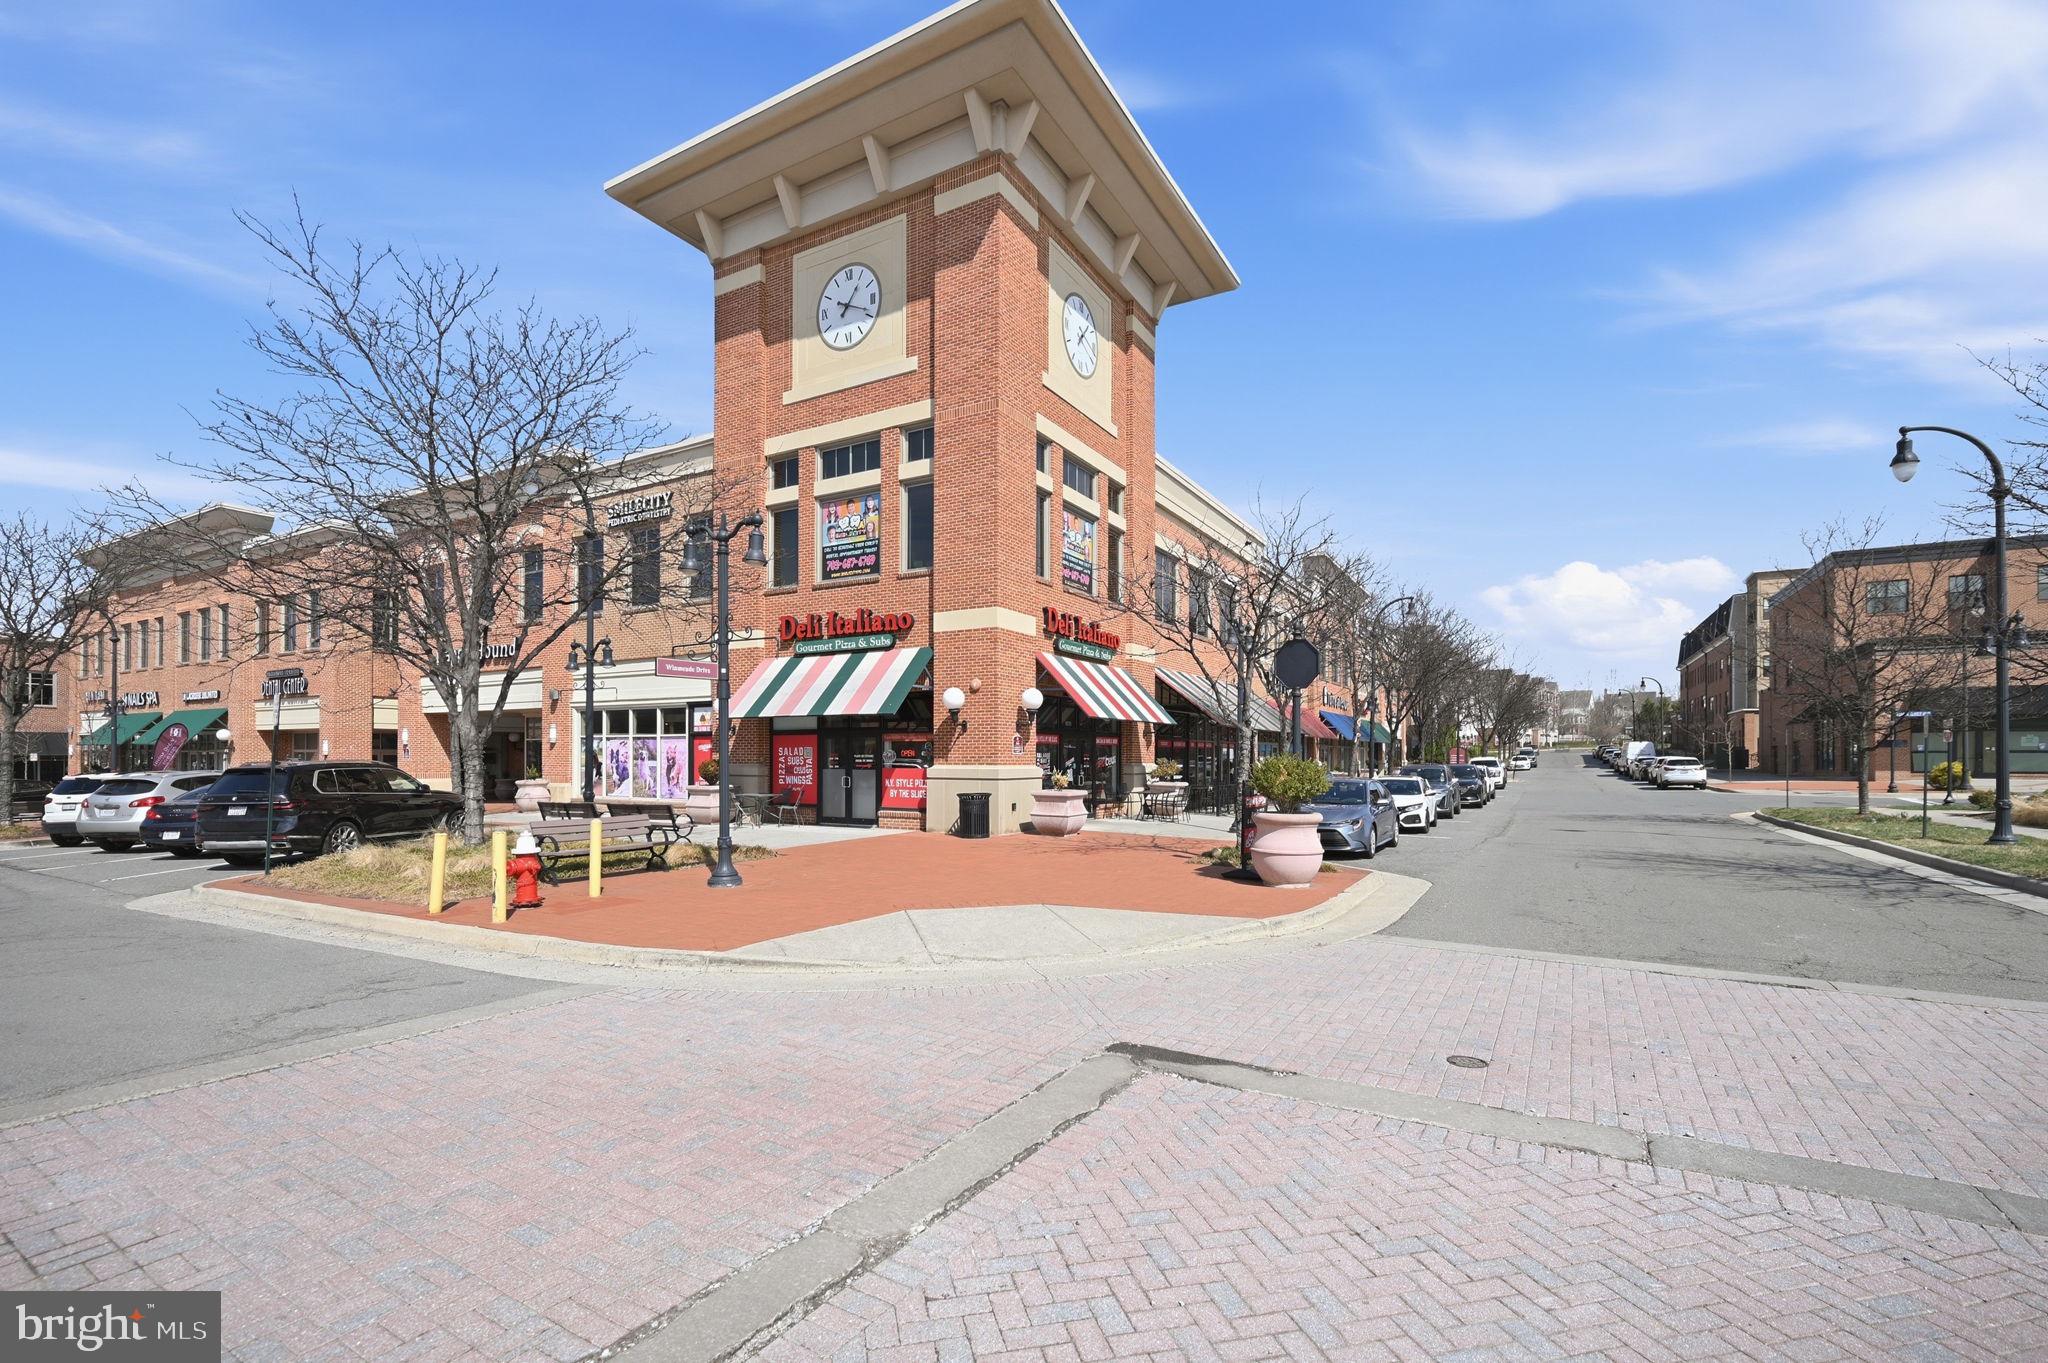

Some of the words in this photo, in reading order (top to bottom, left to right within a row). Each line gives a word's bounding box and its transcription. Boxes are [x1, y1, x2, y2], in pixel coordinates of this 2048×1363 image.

[607, 491, 672, 519] SMILECITY
[780, 613, 822, 640] Deli
[827, 608, 913, 636] Italiano
[1047, 607, 1074, 637] Deli
[1077, 616, 1120, 649] Italiano
[796, 643, 832, 653] Gourmet
[835, 640, 856, 650] Pizza
[858, 638, 867, 647] &
[869, 637, 891, 646] Subs
[1059, 640, 1082, 654] Gourmet
[696, 666, 711, 674] Drive
[128, 692, 145, 706] NAILS
[146, 691, 158, 705] SPA
[778, 747, 804, 756] SALAD
[900, 749, 916, 757] OPEN
[787, 756, 804, 765] SUBS
[785, 775, 806, 785] WINGS
[895, 779, 913, 788] STYLE
[889, 790, 898, 798] BY
[899, 790, 909, 798] THE
